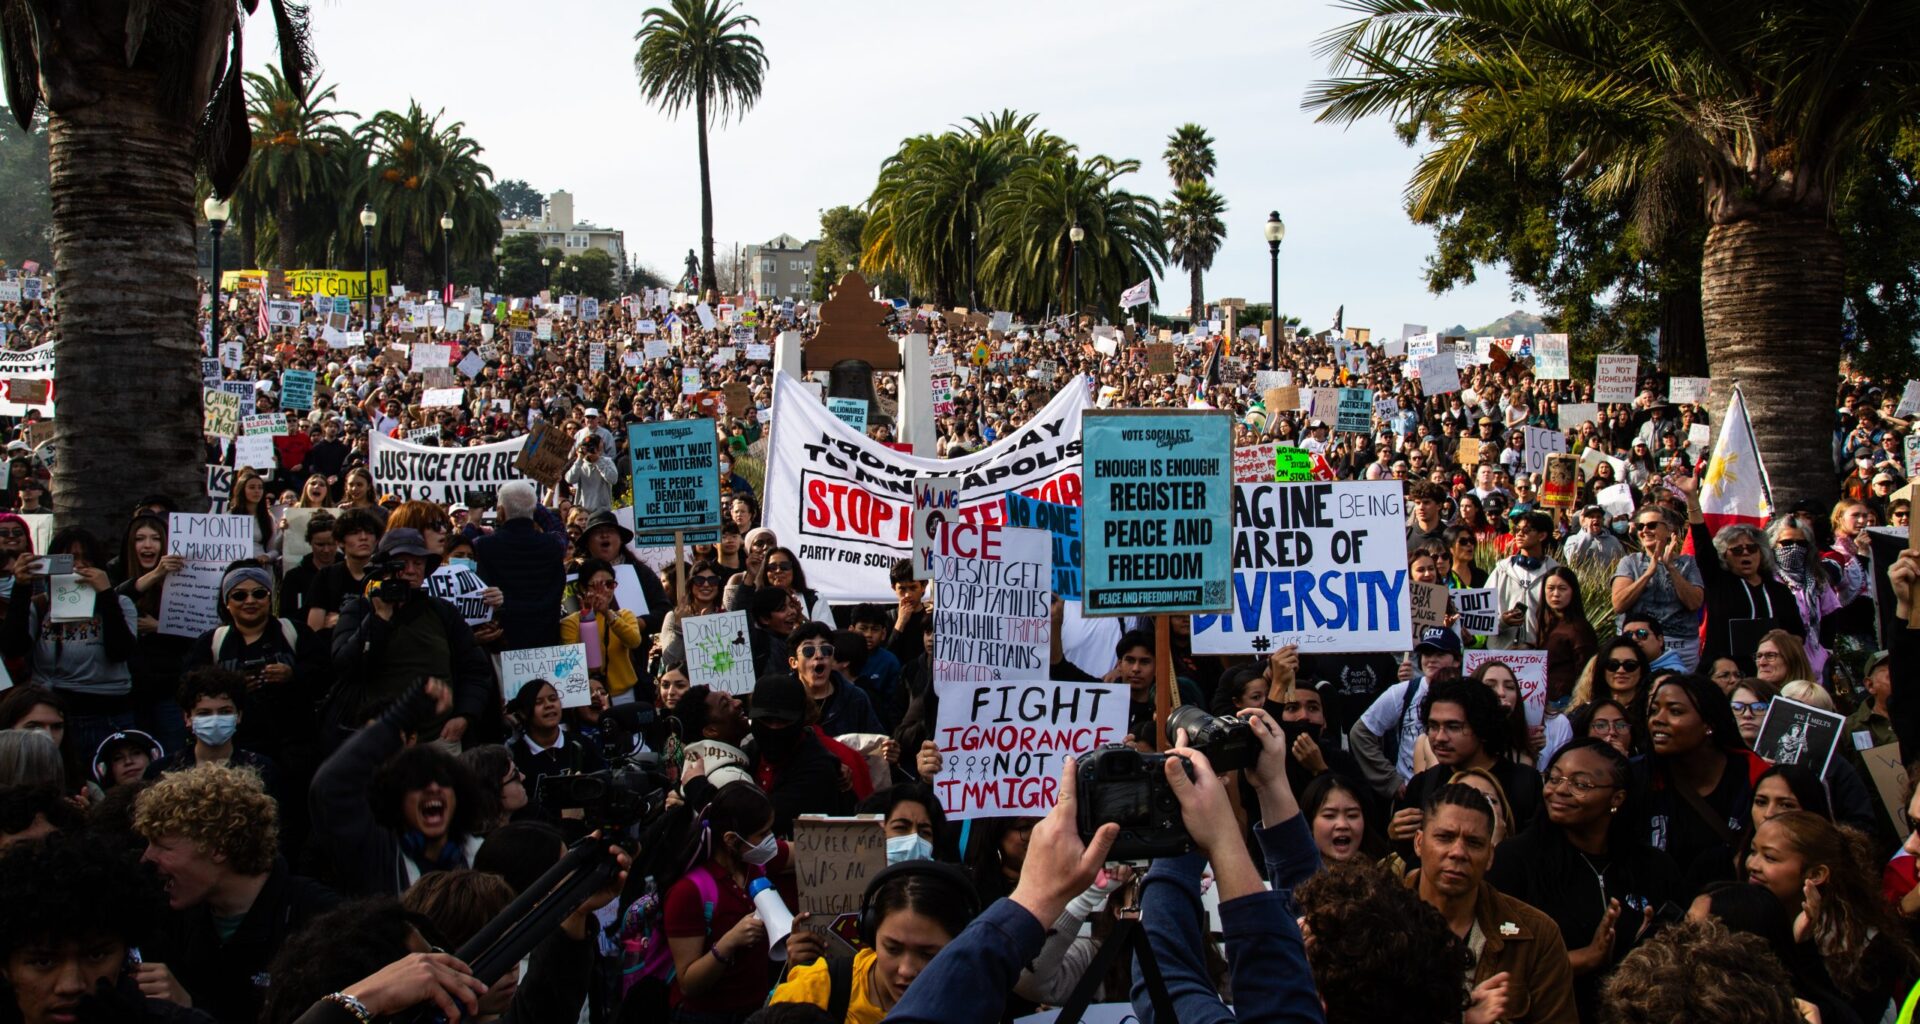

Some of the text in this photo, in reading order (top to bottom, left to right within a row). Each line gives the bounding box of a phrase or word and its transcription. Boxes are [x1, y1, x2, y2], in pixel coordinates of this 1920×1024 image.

[326, 278, 348, 297] GO
[0, 352, 37, 361] CROSS
[990, 352, 1013, 360] FUCK
[201, 360, 219, 372] FEND
[1615, 366, 1631, 375] NOT
[224, 383, 254, 394] DEFEND
[932, 380, 948, 389] CE
[1599, 375, 1637, 383] HOMELAND
[1597, 385, 1633, 393] SECURITY
[206, 390, 239, 409] CHINGA
[246, 420, 275, 429] ILLEGAL
[855, 414, 864, 423] ICE
[246, 425, 287, 436] STOLEN LAND
[1122, 429, 1191, 441] VOTE SOCIALIST
[1530, 429, 1558, 450] ICE
[635, 442, 712, 460] WE WON'T WAIT
[822, 432, 918, 478] FROM
[1277, 447, 1287, 455] NO
[375, 451, 451, 481] JUSTICE
[451, 453, 488, 481] FOR
[659, 456, 713, 472] MIDTERMS
[804, 440, 1082, 495] TO MINAPOLIS
[1095, 459, 1146, 478] ENOUGH
[1150, 459, 1163, 477] IS
[1166, 458, 1220, 477] ENOUGH!
[649, 476, 703, 490] THE PEOPLE
[655, 488, 695, 501] DEMAND
[915, 484, 958, 511] WALANG
[1110, 482, 1206, 512] REGISTER
[646, 500, 708, 514] ICE OUT NOW!
[807, 479, 893, 538] STOP
[1009, 495, 1079, 537] NO ONE
[1234, 484, 1400, 529] AGINE BEING
[173, 516, 250, 538] 1 MONTH
[1104, 518, 1213, 548] PEACE AND
[940, 522, 1002, 561] ICE
[1234, 530, 1368, 569] ARED OF
[186, 543, 247, 560] MURDERED
[800, 544, 861, 565] PARTY FOR
[1003, 561, 1042, 588] GET
[1108, 552, 1203, 582] FREEDOM
[455, 570, 483, 595] OUT
[935, 582, 1049, 618] TO RIP FAMILIES
[1099, 589, 1197, 605] PEACE AND FREEDOM PARTY
[1461, 591, 1491, 612] OUT
[685, 615, 749, 644] DON'T BITE
[966, 613, 1003, 641] WHILE
[1004, 617, 1050, 643] TRUMPS
[1460, 613, 1496, 632] GOOD!
[503, 650, 533, 662] NADIE
[535, 648, 547, 660] ES
[687, 644, 713, 665] THE
[979, 641, 1041, 669] REMAINS
[1475, 655, 1543, 664] IMMIGRATION
[513, 663, 530, 675] EN
[532, 661, 546, 674] LA
[535, 672, 549, 680] DE
[729, 659, 754, 676] FEED
[993, 668, 1002, 680] &
[971, 686, 1112, 725] FIGHT
[1811, 717, 1832, 728] MELTS
[939, 725, 1114, 753] IGNORANCE
[993, 753, 1053, 778] NOT
[936, 776, 1060, 814] IMMIGR
[799, 832, 886, 852] SUPER MAN
[800, 857, 865, 888] WAS AN
